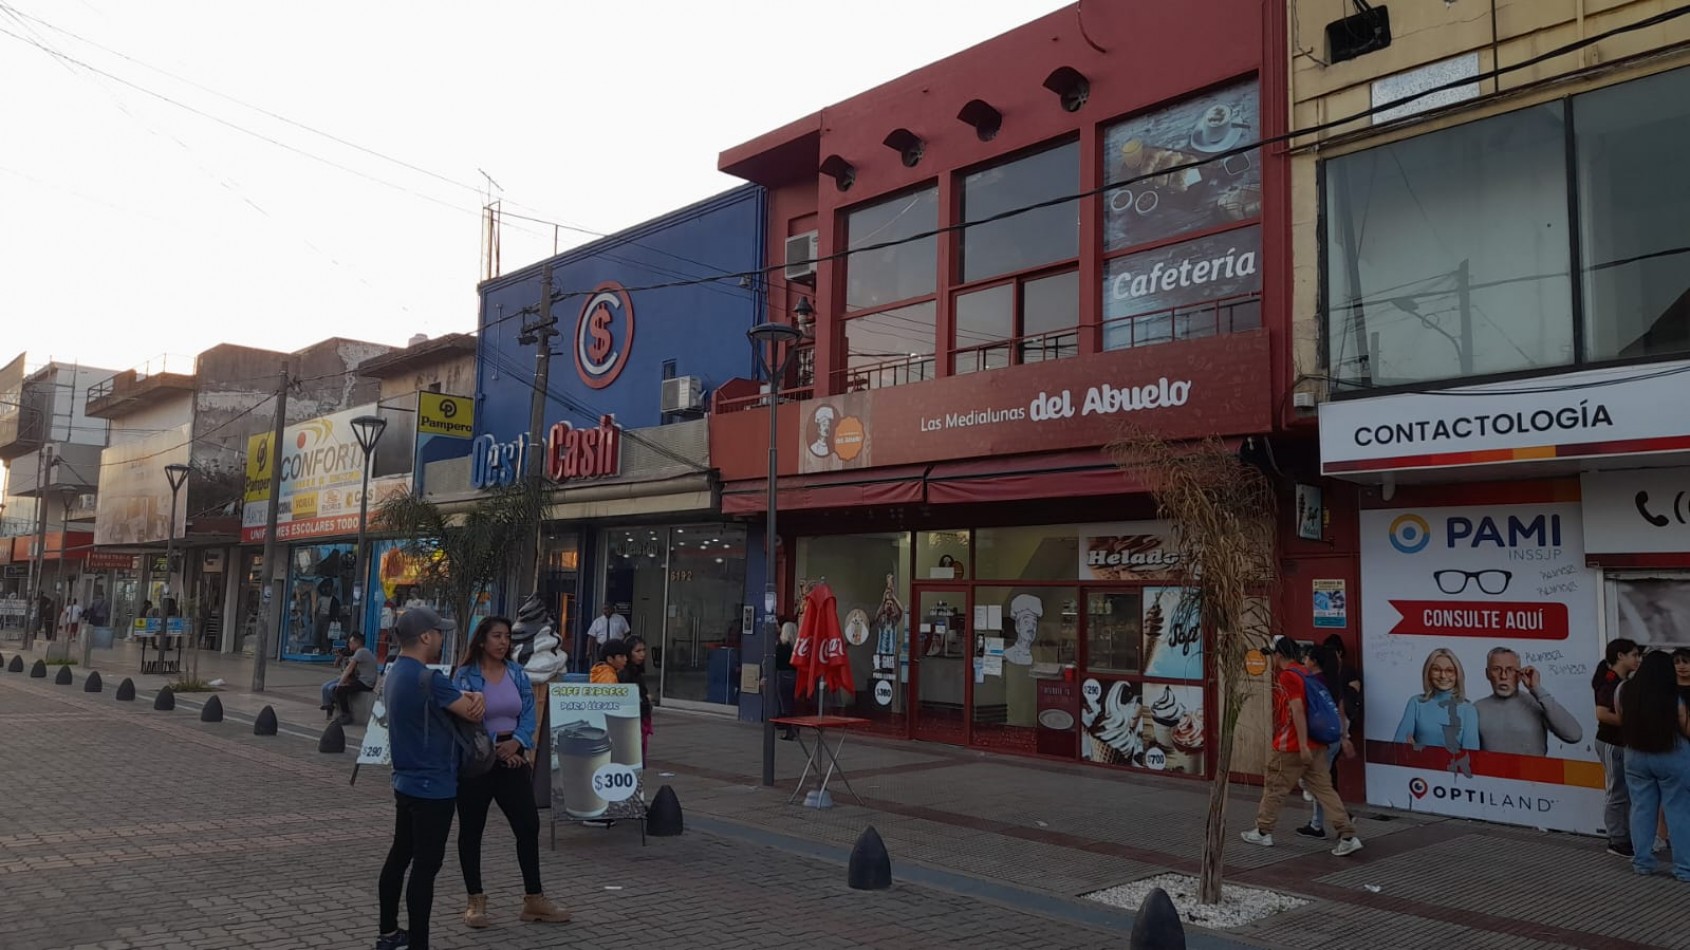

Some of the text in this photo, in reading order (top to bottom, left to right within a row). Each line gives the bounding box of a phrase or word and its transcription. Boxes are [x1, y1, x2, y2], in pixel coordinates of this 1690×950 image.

[1112, 247, 1256, 300] Cafetería
[921, 376, 1192, 432] Las Medialunas del Abuelo
[421, 415, 473, 433] Pampero
[1354, 399, 1614, 447] CONTACTOLOGÍA
[546, 413, 623, 482] Cash
[245, 475, 271, 494] Pamper
[291, 520, 335, 536] ESCOLARES
[337, 517, 359, 530] TODO
[1446, 514, 1561, 549] PAMI
[1508, 549, 1563, 561] INSSJP
[1423, 608, 1544, 630] CONSULTE AQUÍ
[594, 772, 633, 792] $300
[1433, 785, 1552, 813] OPTILAND
